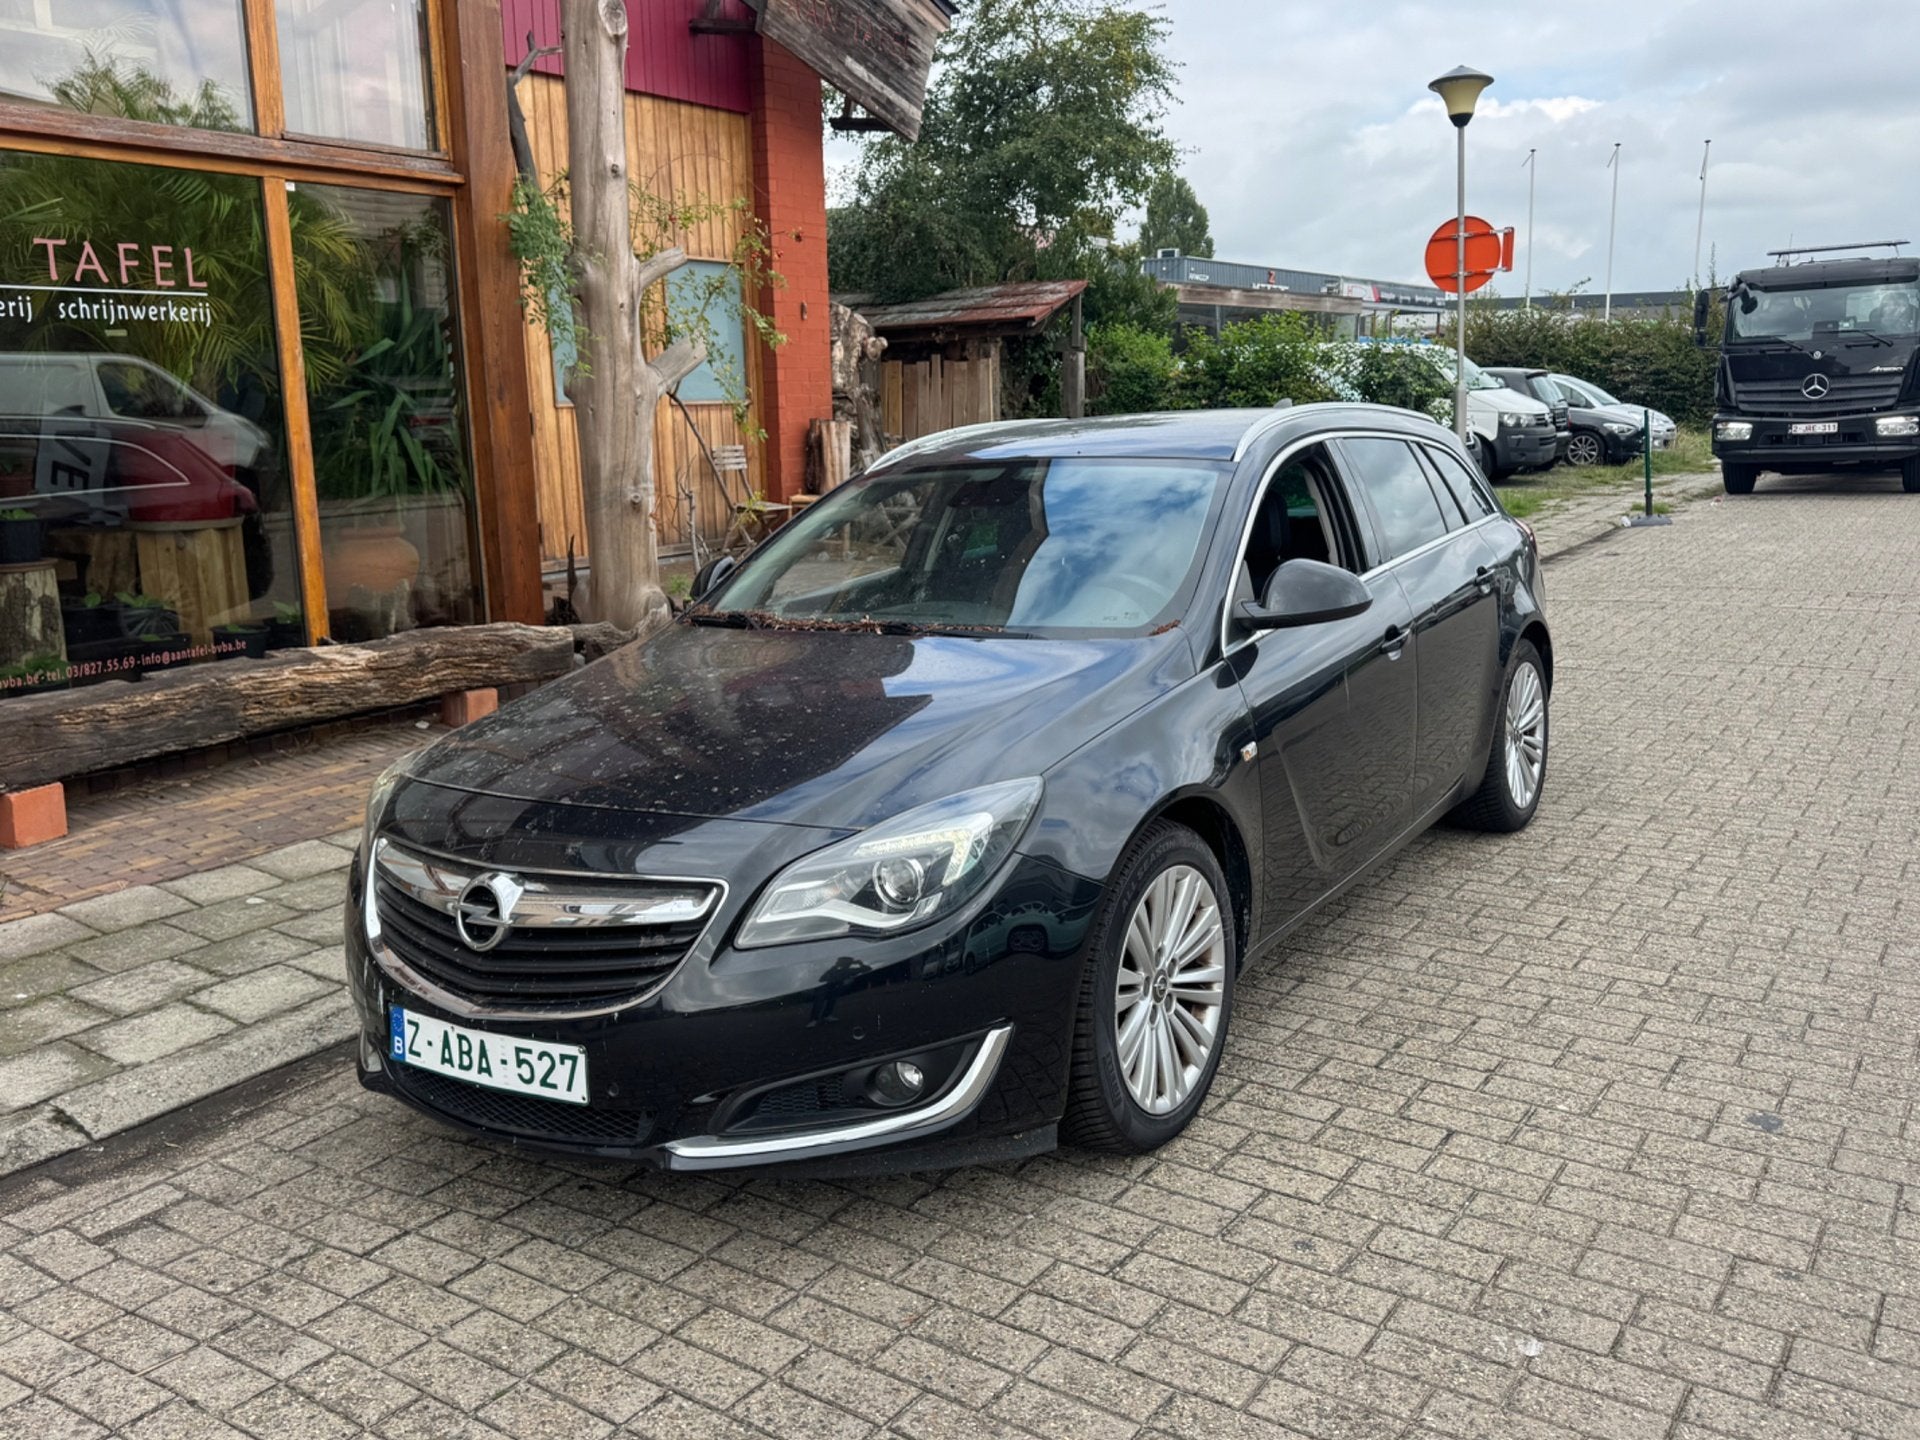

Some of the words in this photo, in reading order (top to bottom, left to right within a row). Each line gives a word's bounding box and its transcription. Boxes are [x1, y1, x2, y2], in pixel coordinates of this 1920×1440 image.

[33, 237, 208, 288] TAFEL
[58, 297, 212, 327] schrijnwerkerij
[66, 655, 135, 679] 03/827.55.69
[394, 1037, 404, 1055] B
